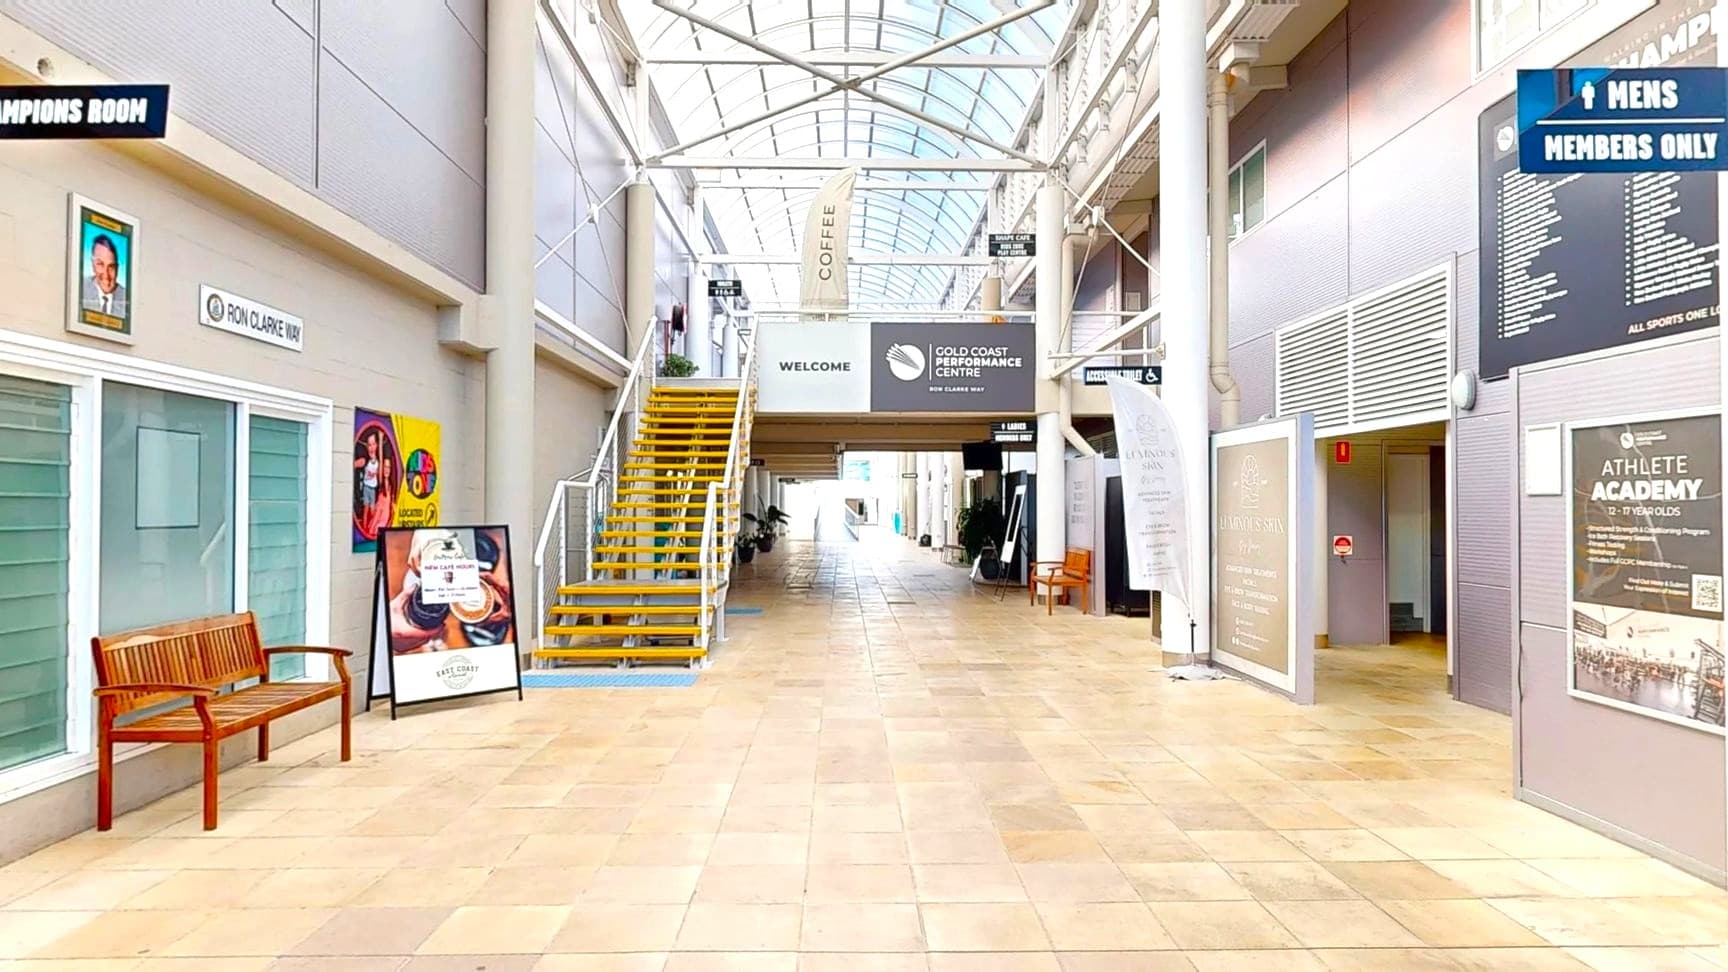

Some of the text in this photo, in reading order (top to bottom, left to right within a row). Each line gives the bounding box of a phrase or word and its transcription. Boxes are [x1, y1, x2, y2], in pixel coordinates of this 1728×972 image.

[1607, 80, 1679, 109] MENS
[87, 98, 148, 124] ROOM
[1544, 133, 1718, 161] MEMBERS ONLY
[819, 205, 836, 281] COFFEE
[227, 303, 301, 343] RON CLARKE WAY
[1628, 323, 1645, 335] ALL
[1646, 313, 1684, 331] SPORTS
[1685, 308, 1708, 321] ONE
[935, 347, 1008, 357] GOLD COAST
[779, 361, 851, 372] WELCOME
[935, 357, 1022, 367] PERFORMANCE
[935, 367, 981, 377] CENTRE
[1007, 422, 1027, 430] LADIES
[1601, 455, 1688, 477] ATHLETE
[1591, 478, 1703, 501] ACADEMY
[400, 509, 423, 517] LOCATED
[1608, 507, 1616, 516] 12
[1623, 507, 1630, 515] 17
[1631, 507, 1654, 517] YEAR
[1655, 506, 1681, 517] OLDS
[1220, 515, 1284, 533] LUMINOUS SKIN
[436, 667, 454, 678] EAST
